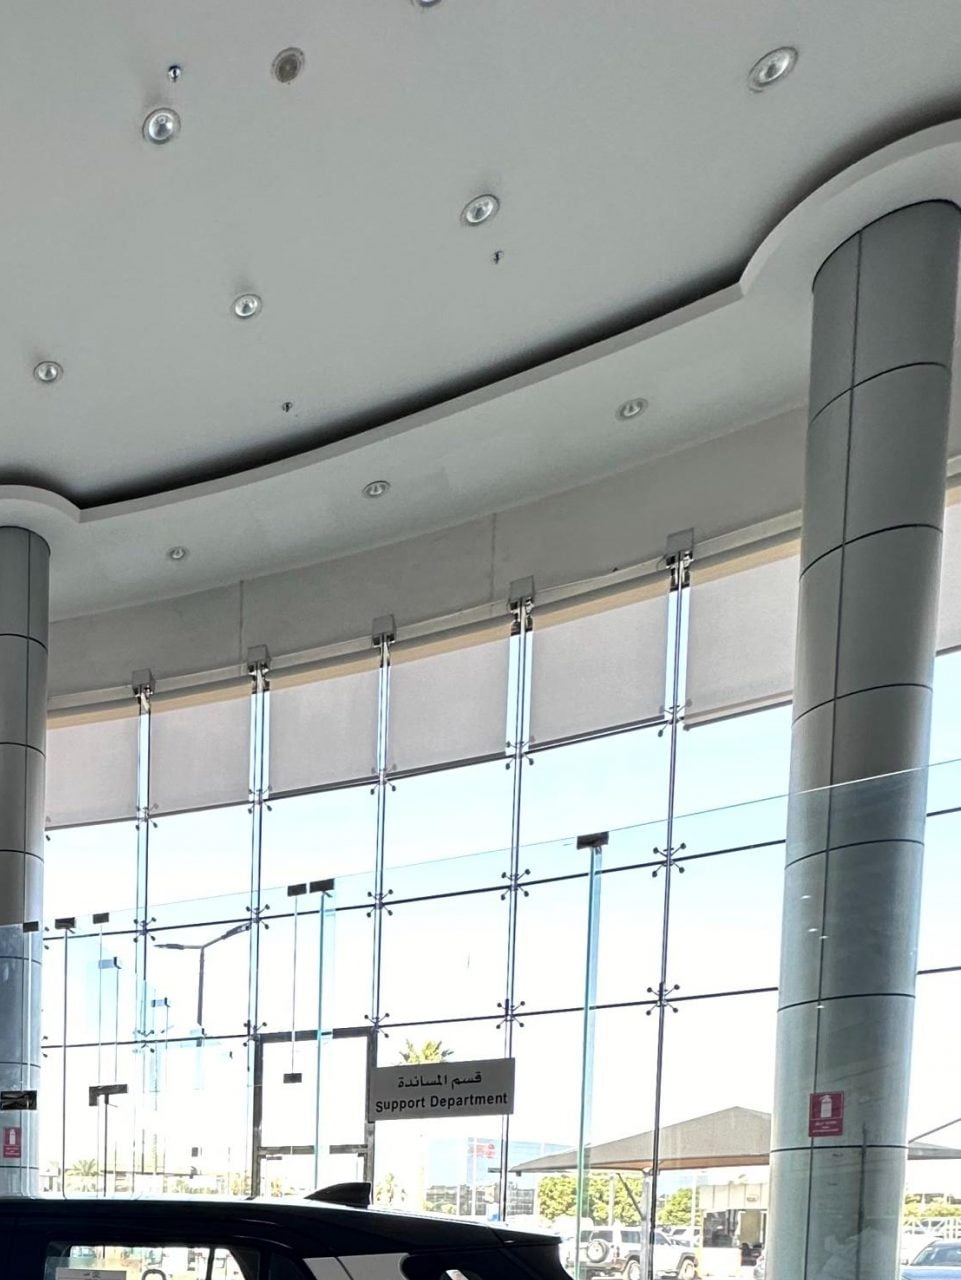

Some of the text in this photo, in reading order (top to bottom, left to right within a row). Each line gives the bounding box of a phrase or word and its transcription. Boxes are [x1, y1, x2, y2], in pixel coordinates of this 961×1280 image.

[398, 1071, 482, 1090] قسم المساندة
[376, 1092, 508, 1113] Support Department
